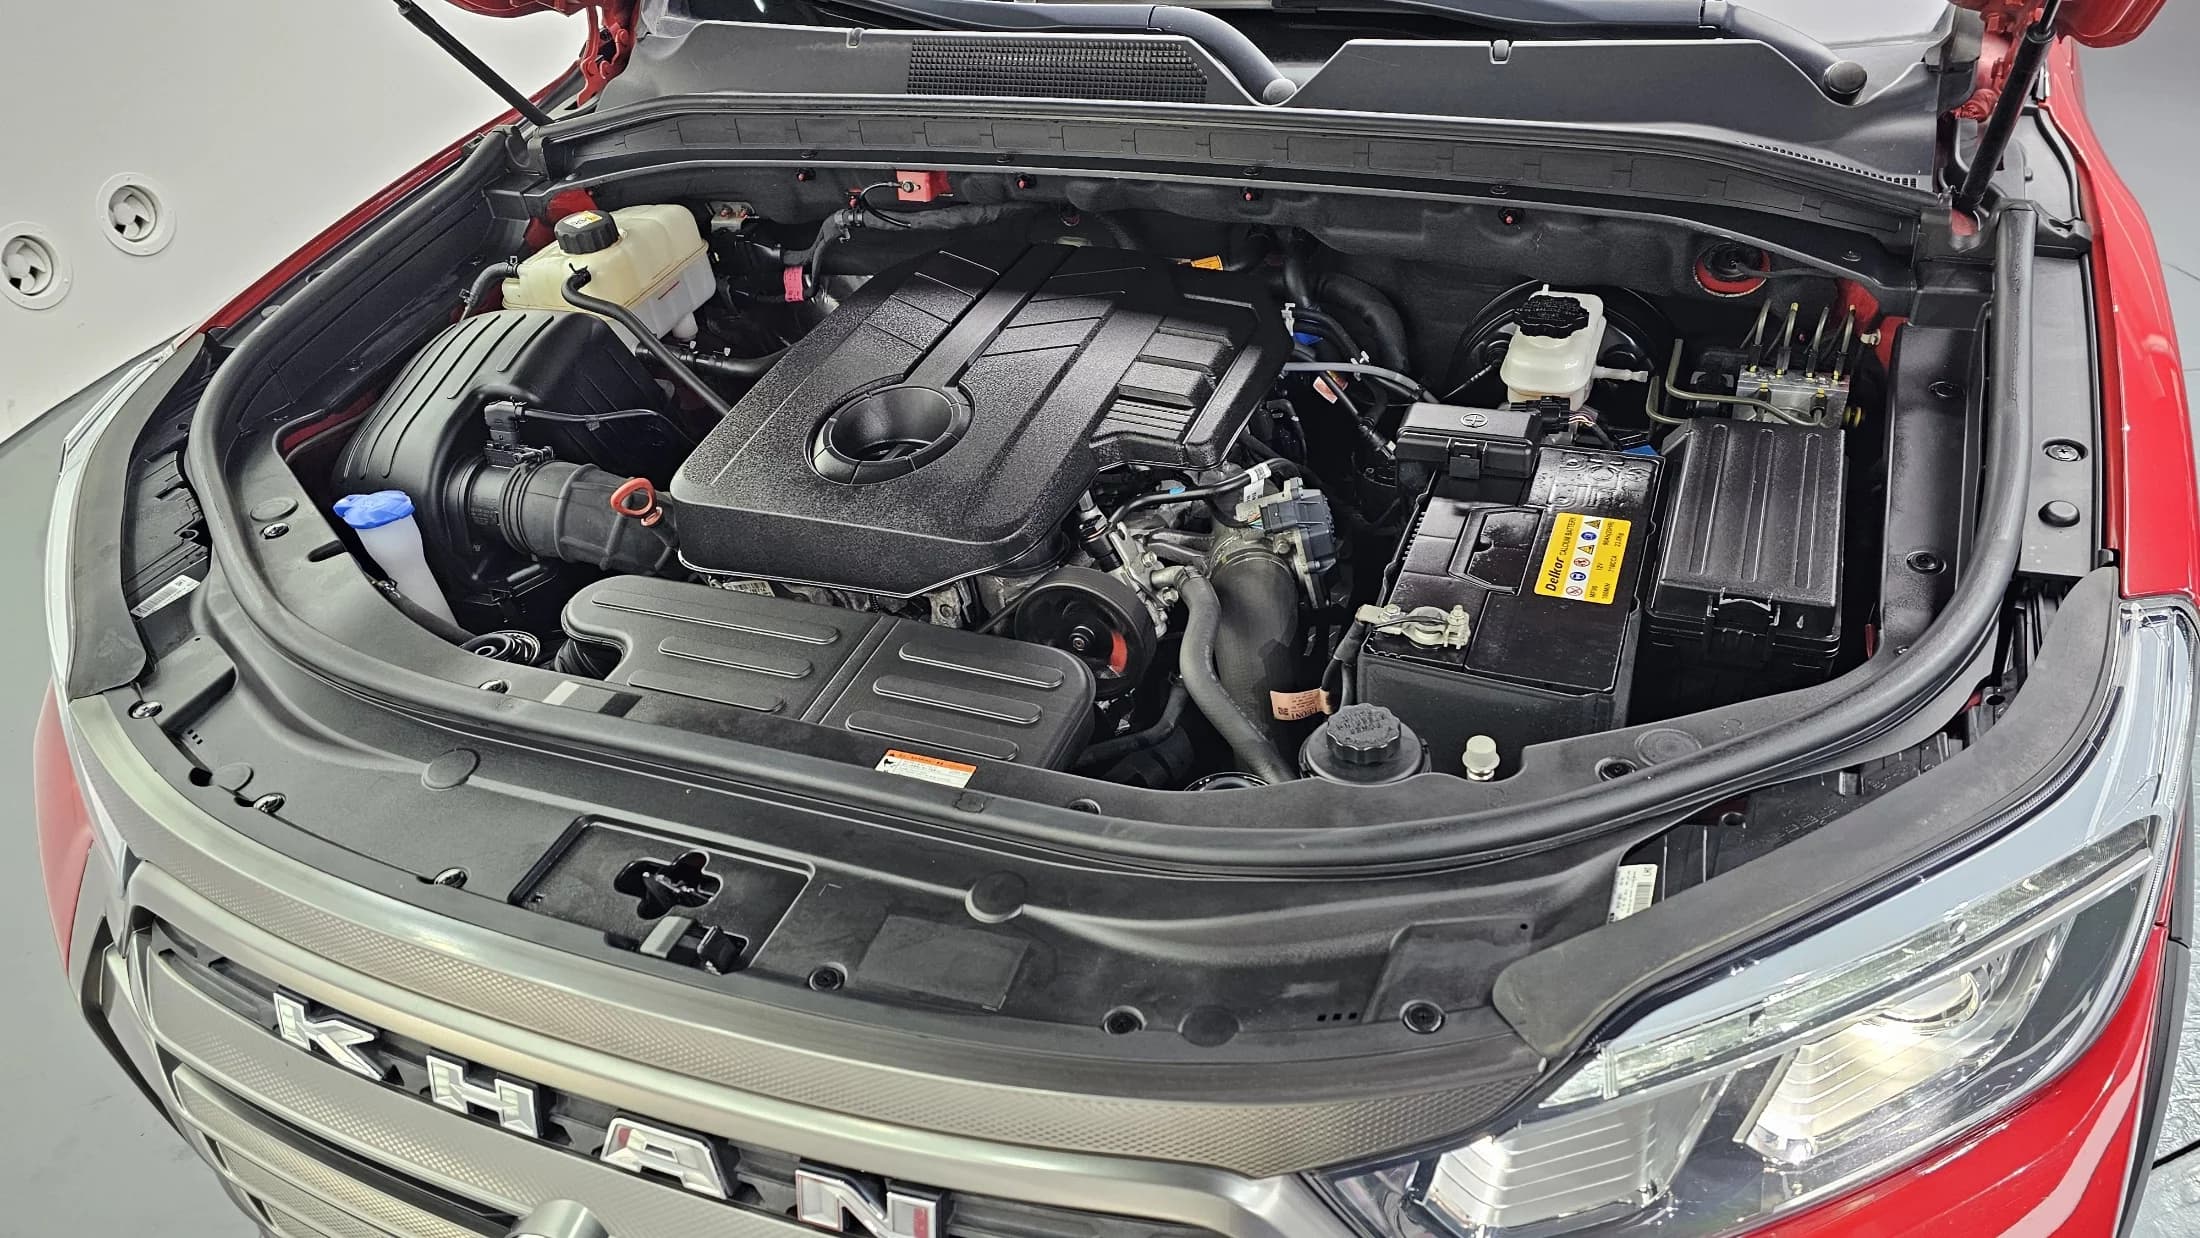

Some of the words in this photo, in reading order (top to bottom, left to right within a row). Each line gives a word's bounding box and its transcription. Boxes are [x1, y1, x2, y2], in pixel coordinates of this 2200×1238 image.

[1545, 556, 1565, 592] Delkor
[1559, 536, 1571, 556] CALCIUM
[1565, 517, 1577, 536] BATTERY
[273, 990, 942, 1238] KHAN
